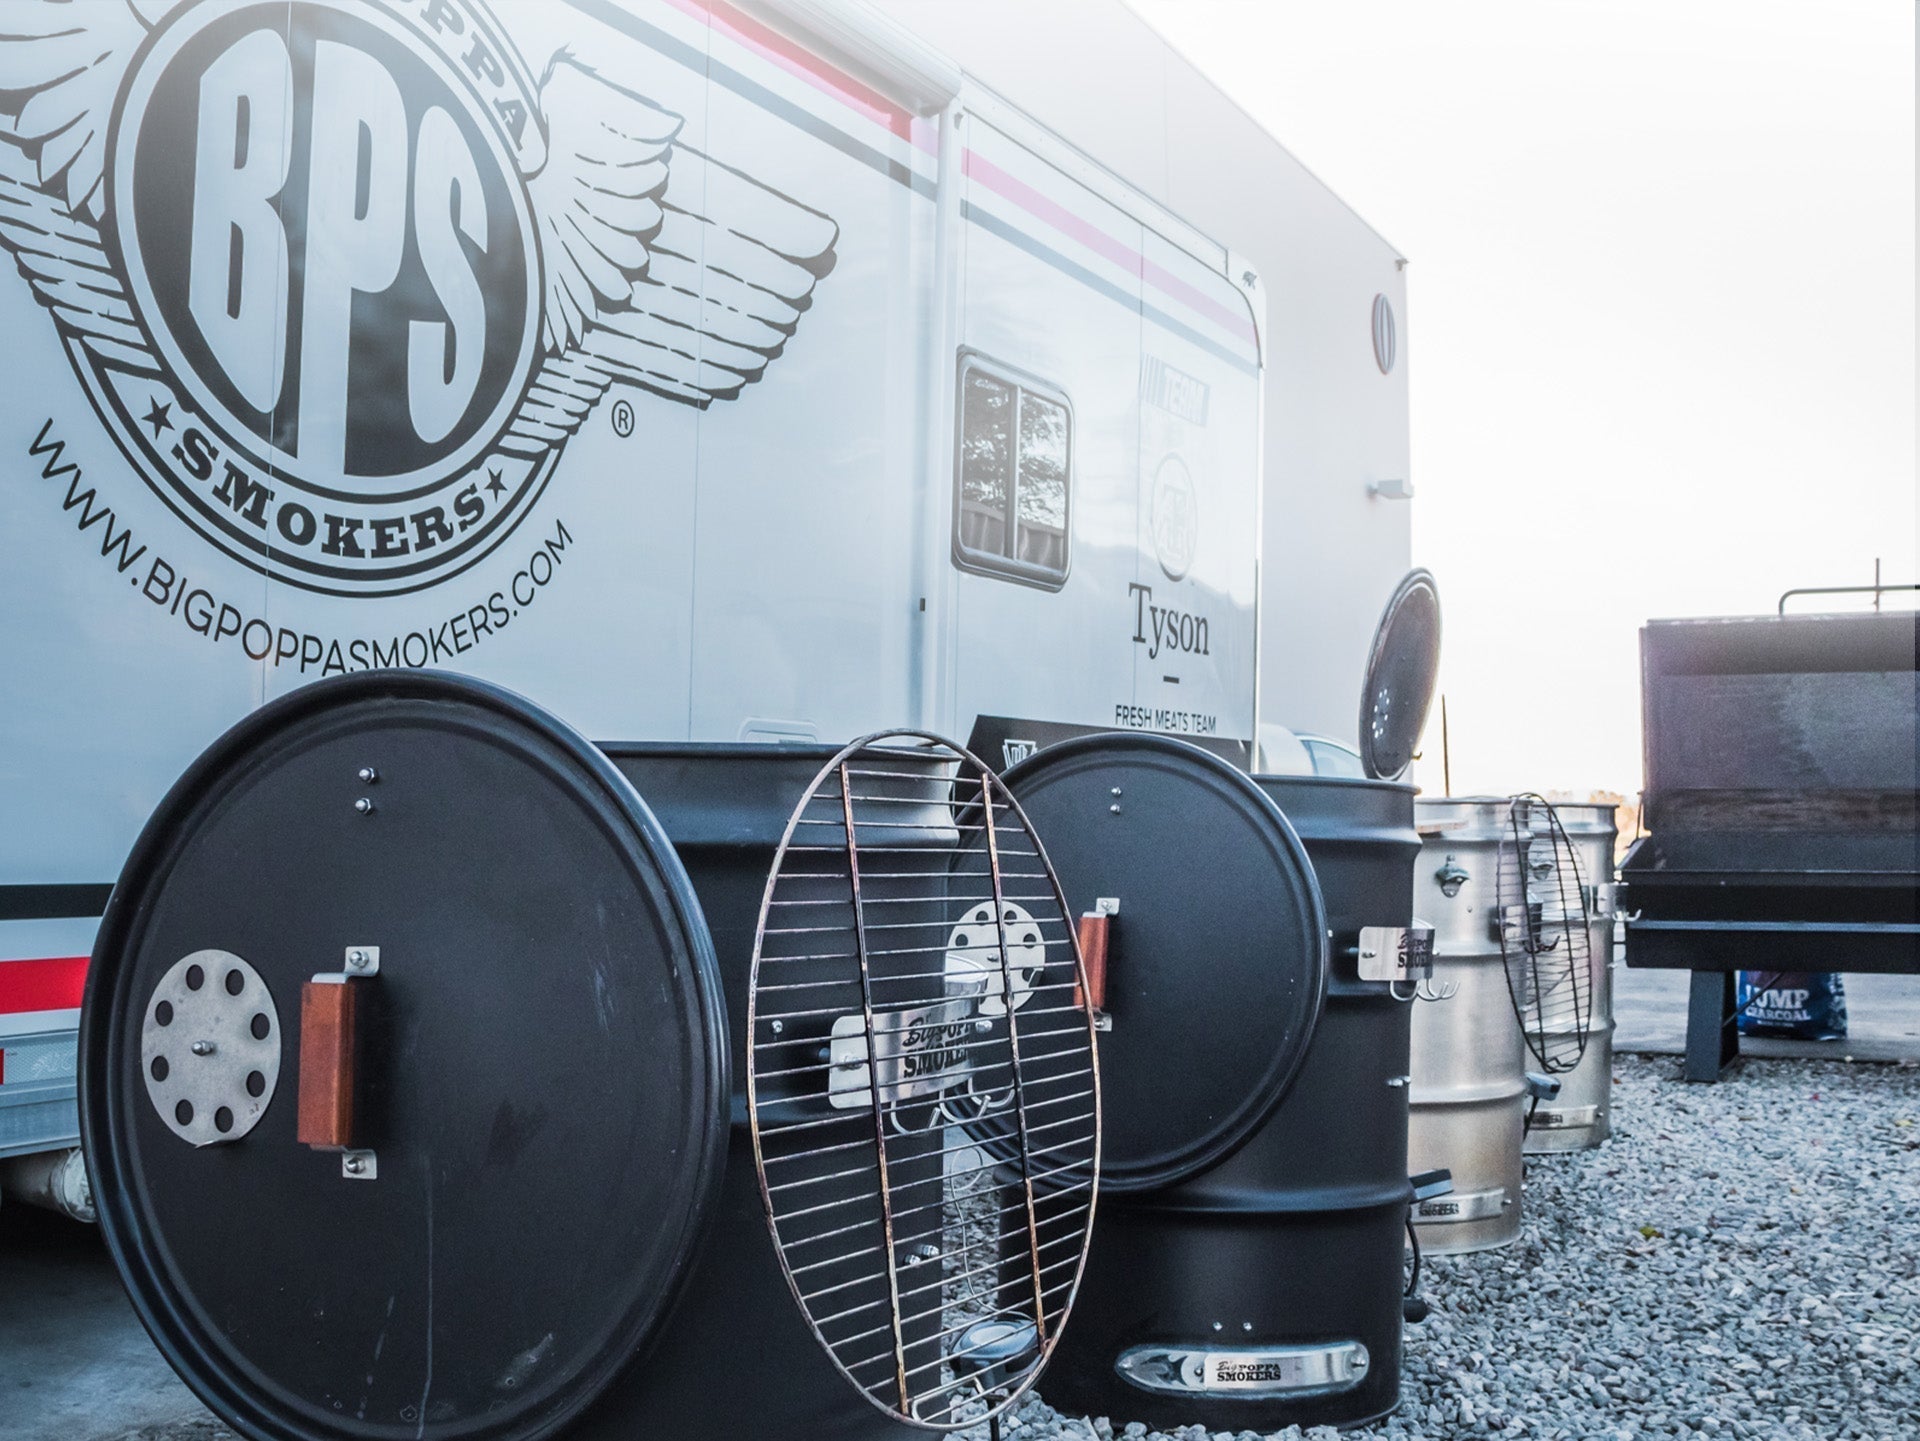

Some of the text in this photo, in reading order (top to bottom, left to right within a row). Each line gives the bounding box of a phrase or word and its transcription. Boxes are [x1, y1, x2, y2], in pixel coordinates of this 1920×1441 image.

[189, 28, 488, 476] BPS
[171, 427, 486, 559] SMOKERS
[28, 417, 574, 677] WWW.BIGPOPPASMOKERS.COM
[1128, 582, 1209, 660] Tyson
[1115, 704, 1217, 734] FRESH MEATS TEAM
[1217, 1371, 1282, 1382] SMOKERS
[1239, 1363, 1281, 1371] POPPA
